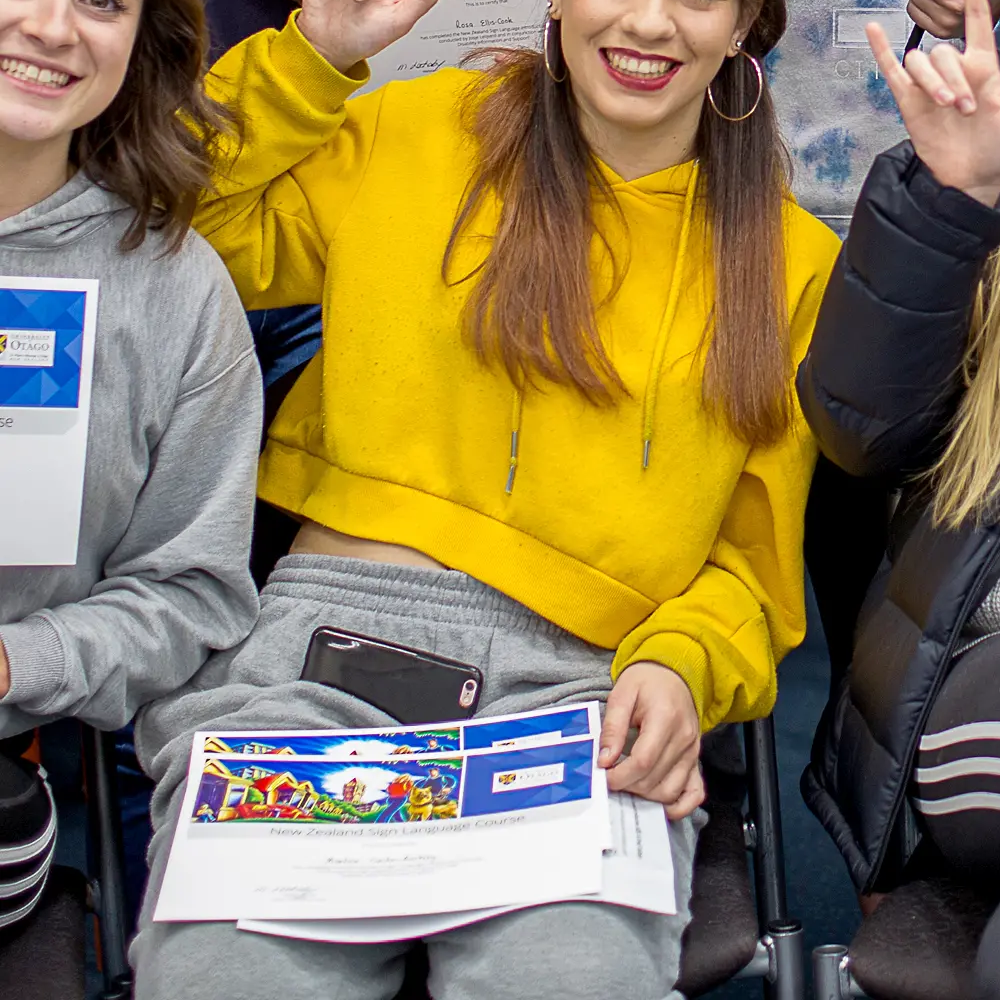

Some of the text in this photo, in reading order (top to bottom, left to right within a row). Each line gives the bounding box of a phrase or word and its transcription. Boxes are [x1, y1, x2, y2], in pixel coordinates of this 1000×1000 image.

[835, 60, 879, 79] CIT
[10, 340, 50, 351] OTAGO
[270, 815, 525, 837] New Zealand Sign Language Course
